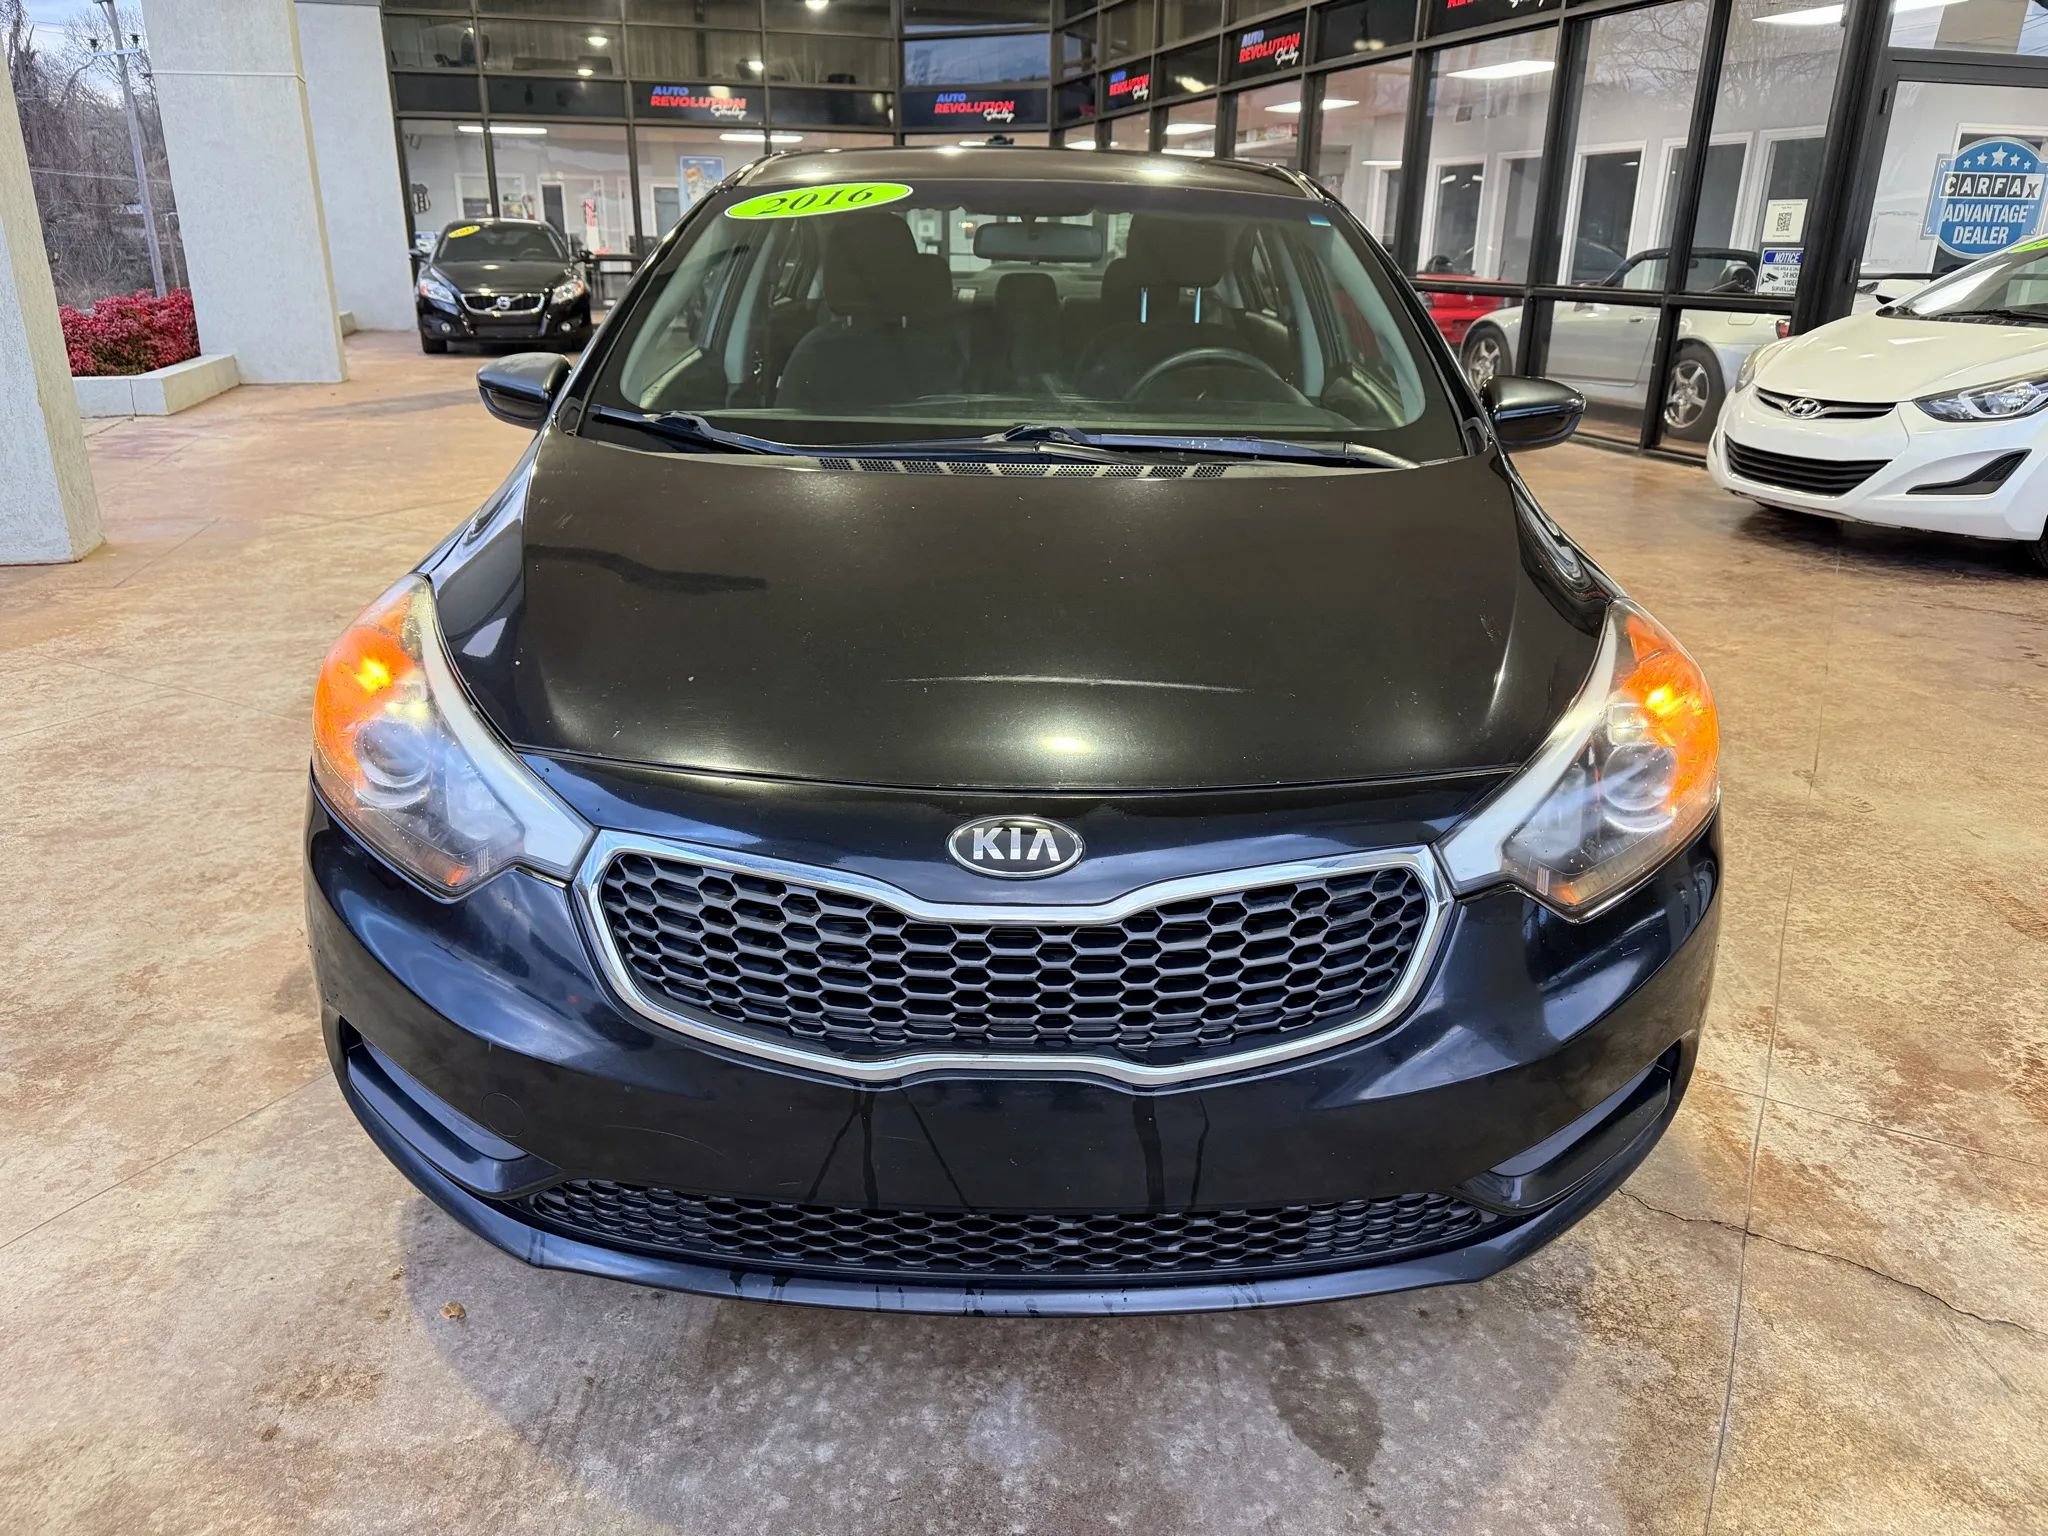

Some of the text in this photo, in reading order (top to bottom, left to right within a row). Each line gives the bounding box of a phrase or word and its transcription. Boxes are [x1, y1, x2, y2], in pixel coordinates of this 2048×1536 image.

[1239, 32, 1300, 63] REVOLUTION
[1241, 29, 1265, 47] AUTO
[652, 85, 689, 96] AUTO
[936, 92, 967, 103] AUTO
[650, 95, 747, 109] REVOLUTION
[934, 100, 1015, 113] REVOLUTION
[1944, 176, 2039, 198] CARFAX
[757, 185, 881, 215] 2016
[1942, 203, 2029, 223] ADVANTAGE
[1952, 225, 2010, 245] DEALER
[1773, 252, 1801, 264] NOTICE
[972, 827, 1061, 862] KIA
